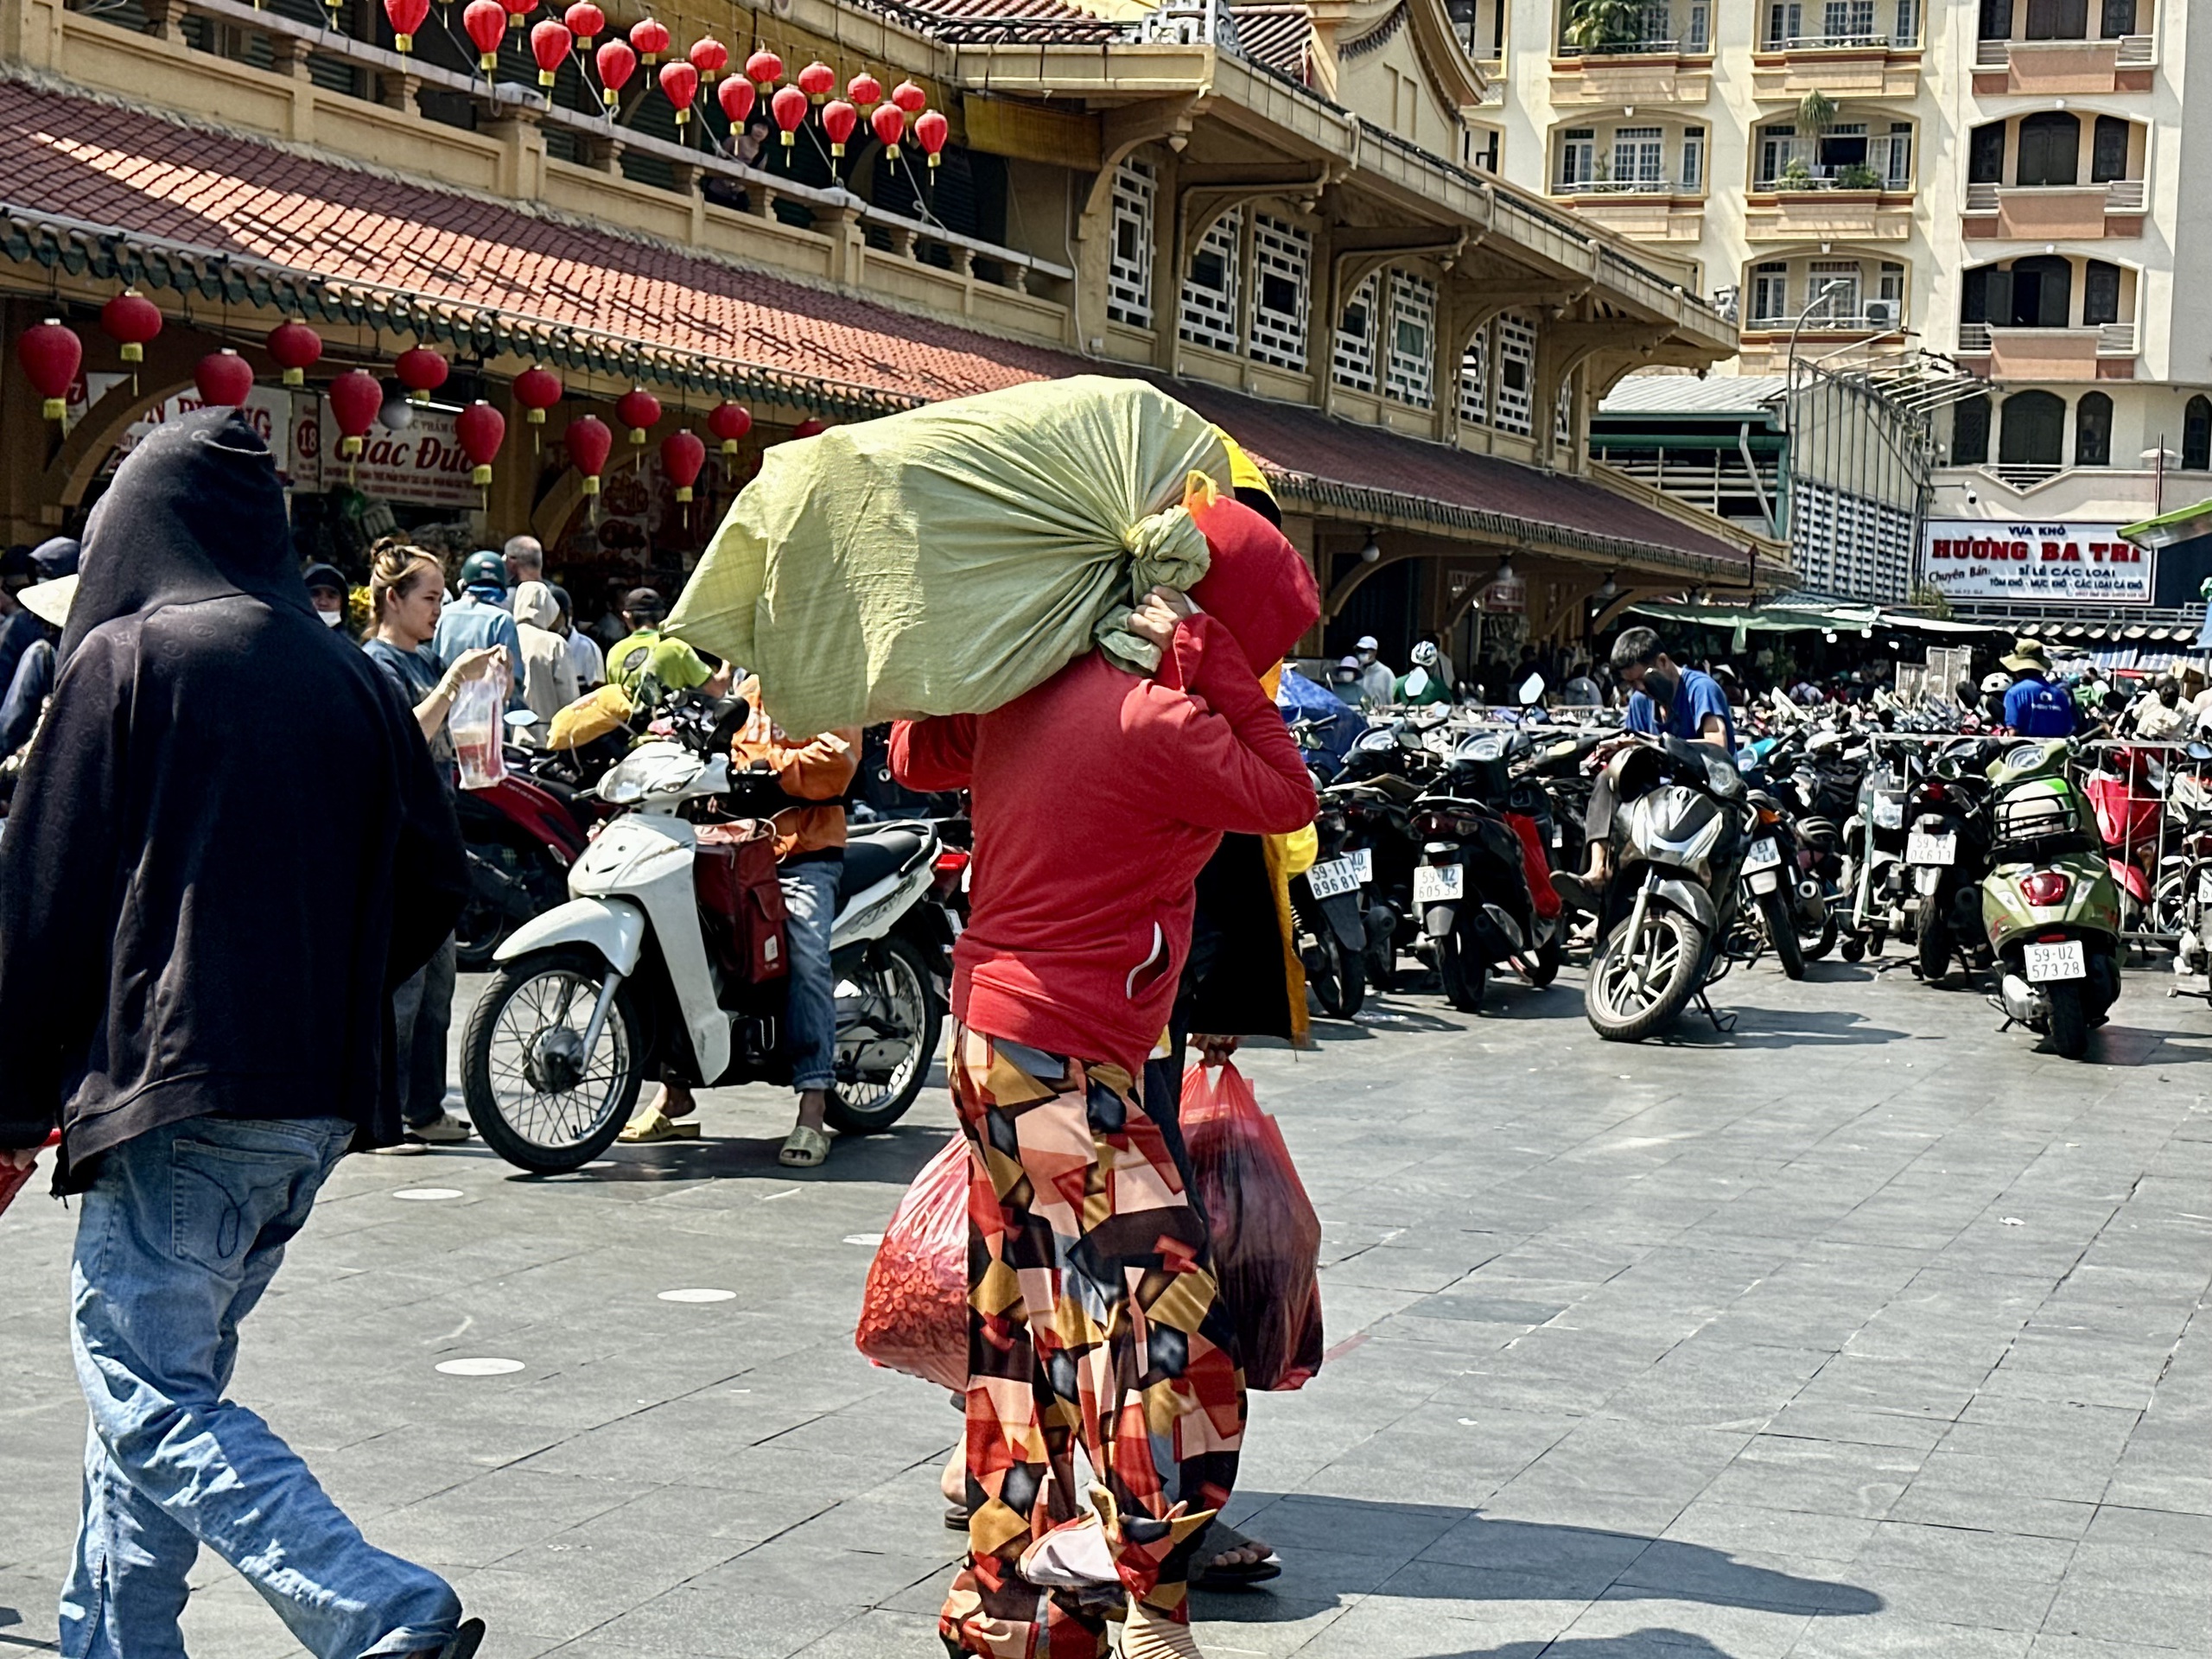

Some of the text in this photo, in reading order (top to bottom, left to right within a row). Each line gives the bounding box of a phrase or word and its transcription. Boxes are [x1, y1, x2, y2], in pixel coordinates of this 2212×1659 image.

[301, 427, 317, 452] 18
[1932, 536, 2140, 563] HƯƠNG BA TRI
[1929, 569, 1965, 584] Chuyên
[2051, 565, 2082, 576] CÁC
[2034, 946, 2074, 962] 59-U2
